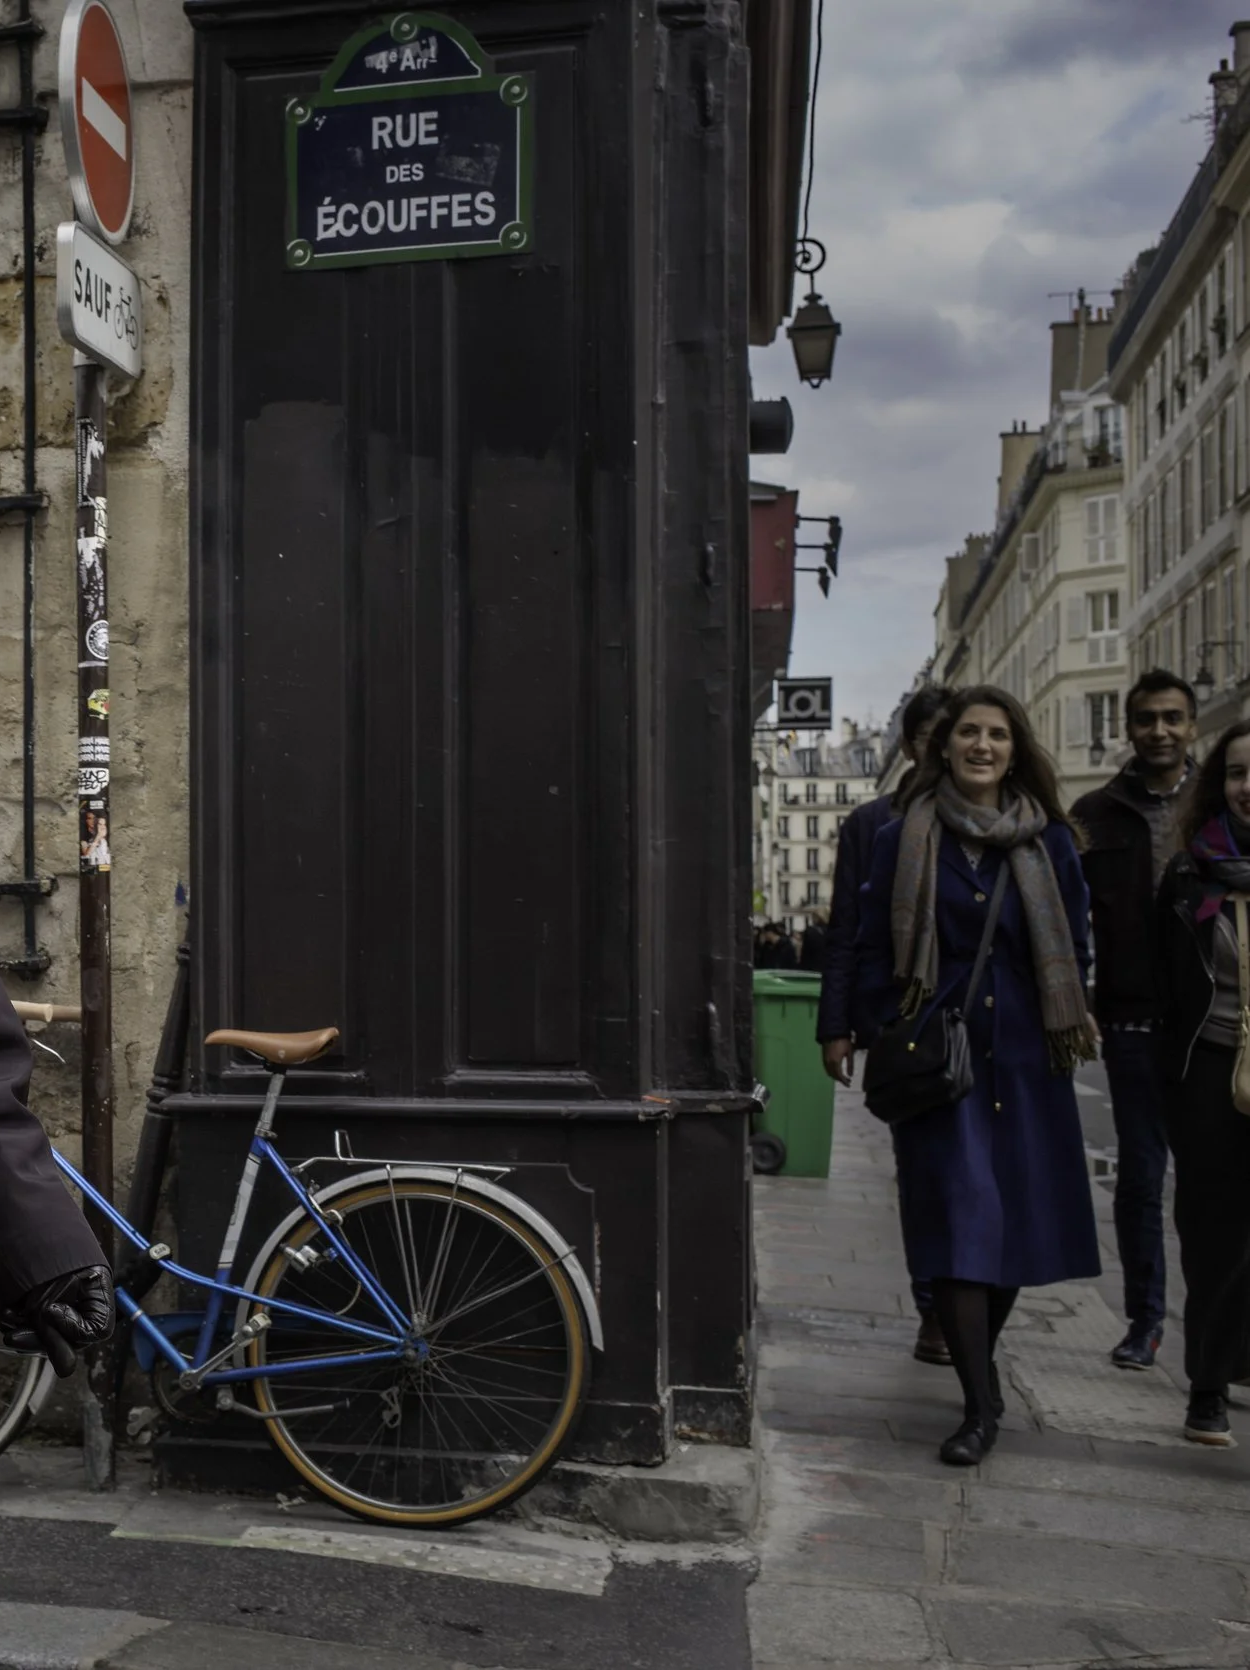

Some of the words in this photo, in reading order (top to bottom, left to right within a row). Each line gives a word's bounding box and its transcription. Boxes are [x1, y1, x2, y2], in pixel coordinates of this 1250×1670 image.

[371, 111, 439, 150] RUE
[385, 163, 424, 184] DES
[315, 191, 496, 240] ÉCOUFFES
[74, 258, 112, 323] SAUF
[779, 688, 830, 719] LOL
